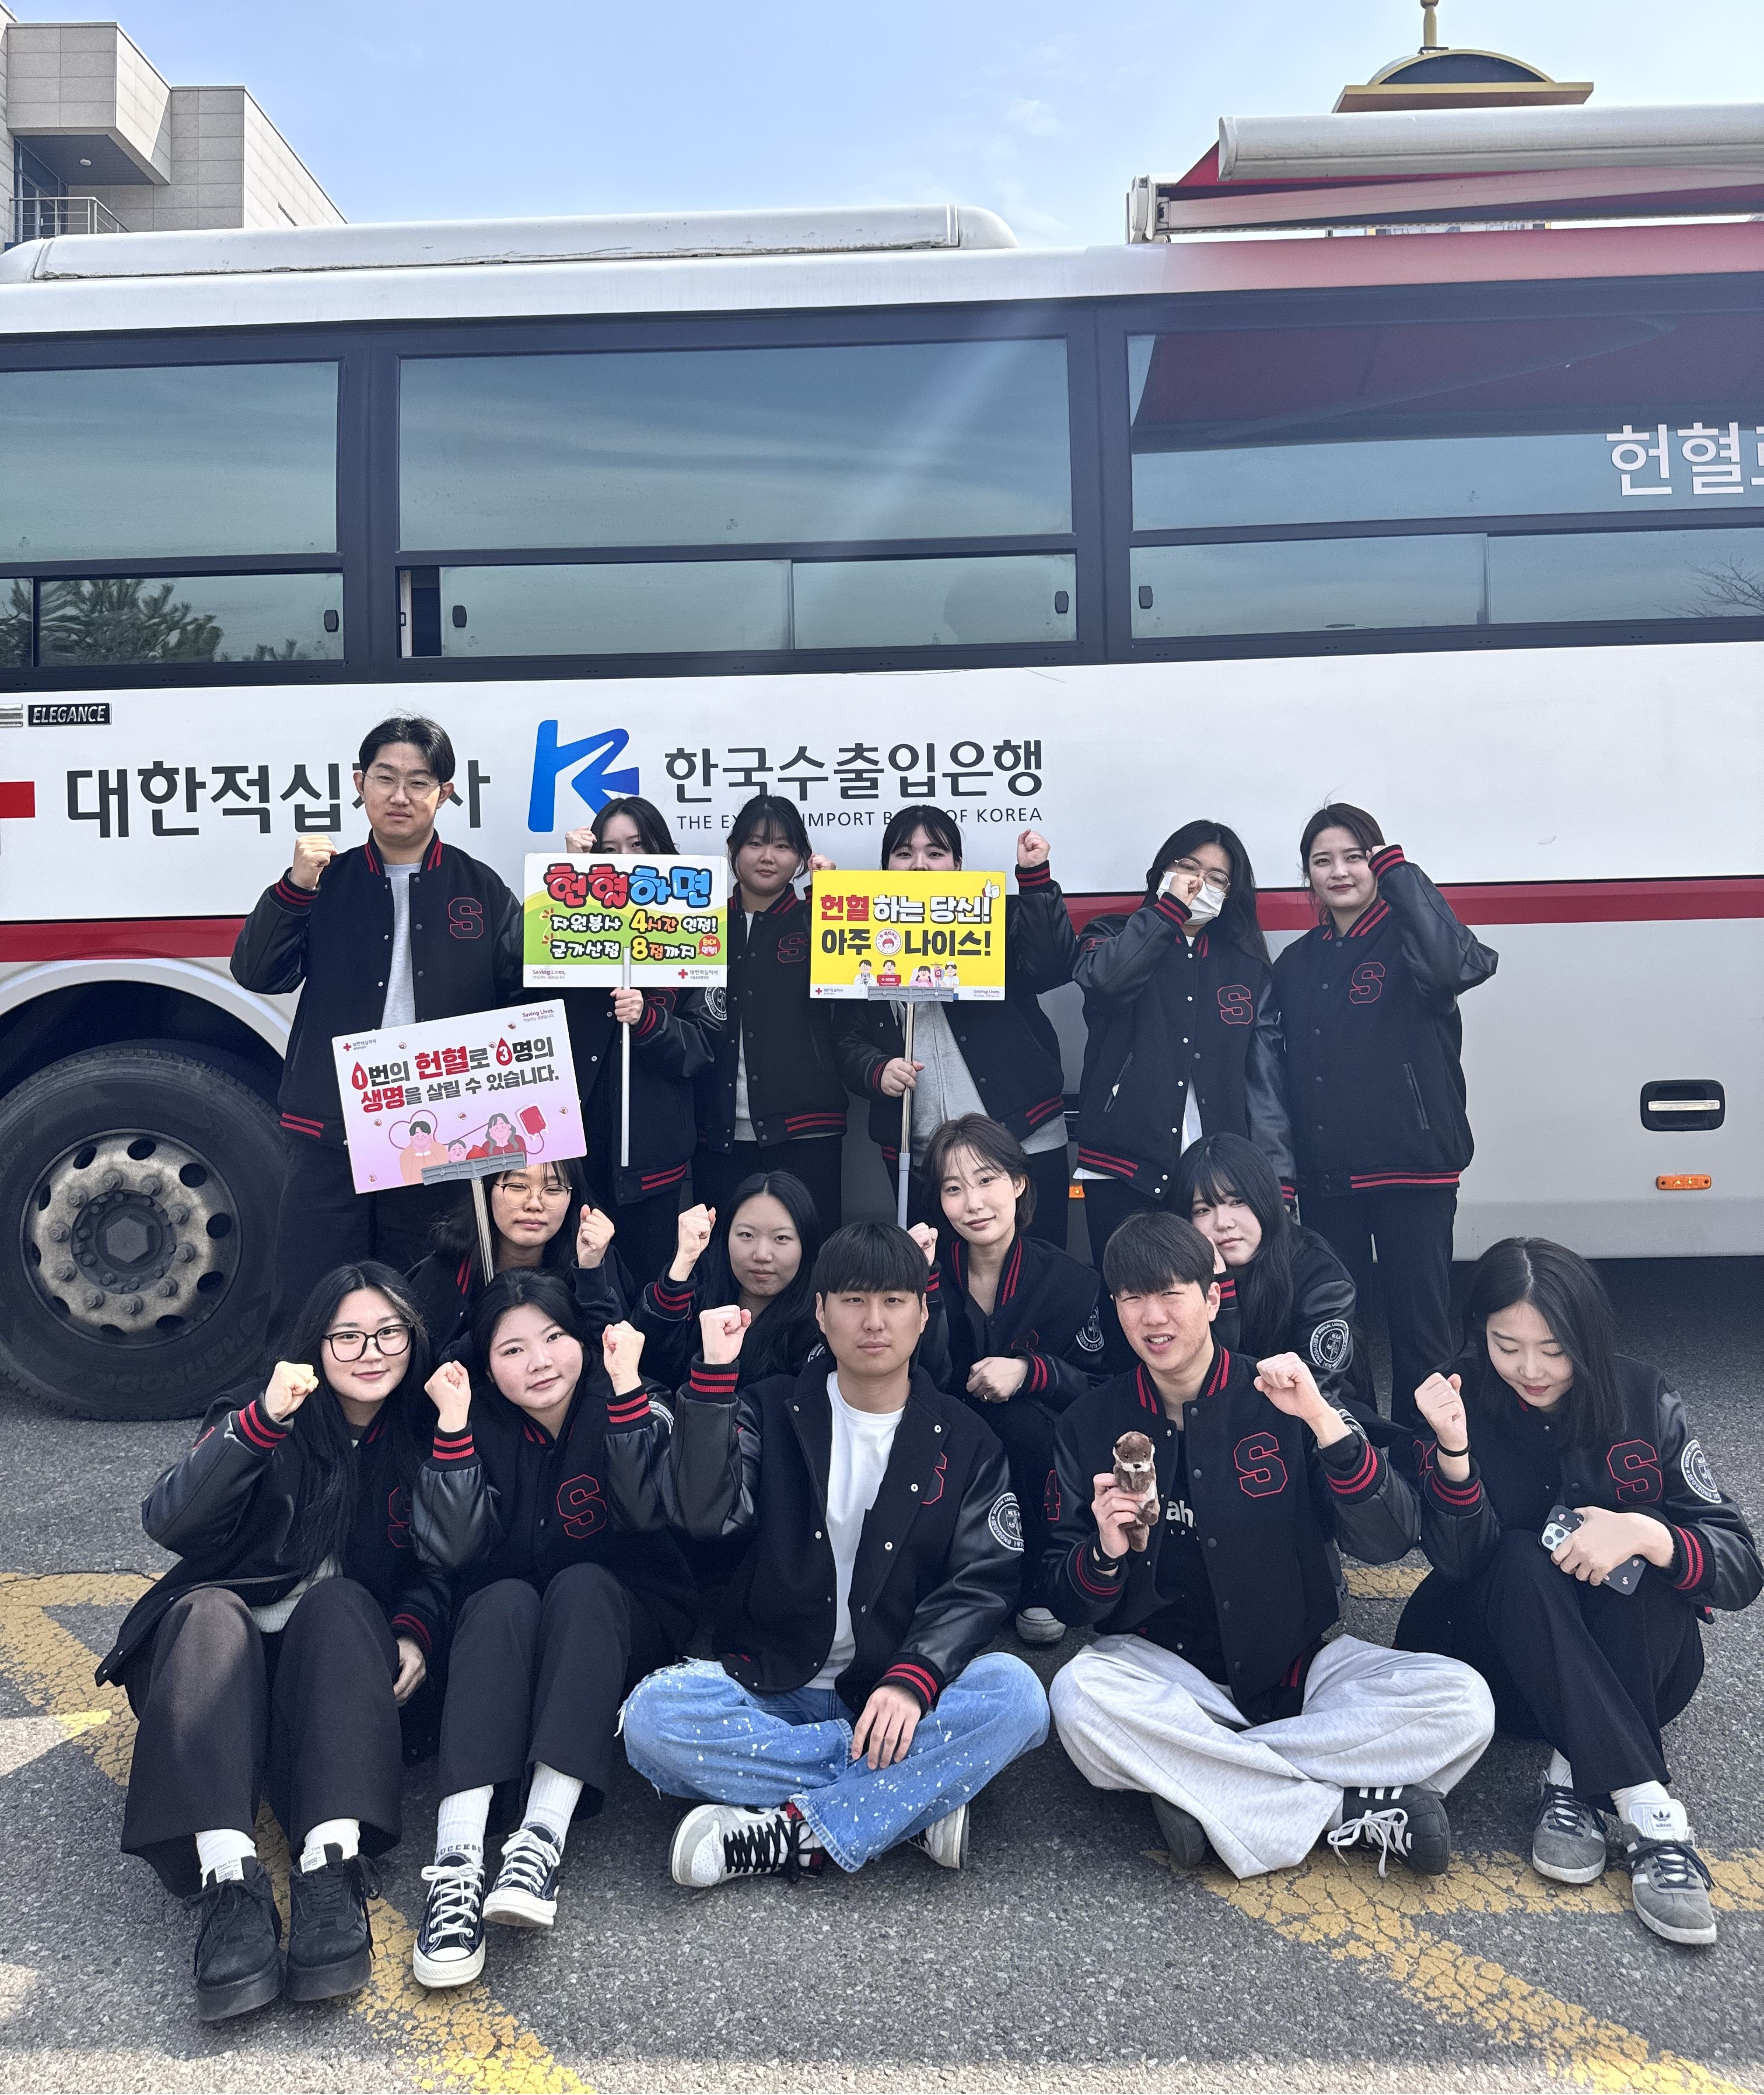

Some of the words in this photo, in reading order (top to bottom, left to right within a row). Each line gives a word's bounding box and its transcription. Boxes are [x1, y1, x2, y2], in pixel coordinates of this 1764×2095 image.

[1606, 422, 1764, 496] 헌혈
[33, 705, 106, 723] ELEGANCE
[664, 739, 1042, 803] 한국수출입은행
[66, 759, 491, 838] 대한적십사
[677, 815, 712, 829] THE
[945, 809, 968, 823] OF
[977, 807, 1042, 823] KOREA
[544, 863, 712, 908] 헌혈하면
[448, 897, 484, 939] S
[551, 913, 623, 933] 자원봉사
[630, 909, 678, 933] 4시간
[681, 916, 718, 933] 인정!
[930, 896, 992, 924] 당신!
[551, 940, 621, 959] 군가산점
[631, 936, 696, 961] 8점까지
[822, 929, 871, 955] 아주
[905, 930, 991, 956] 나이스!
[1349, 962, 1386, 1004] S
[1217, 984, 1254, 1025] S
[354, 1061, 410, 1087] 1번의
[415, 1046, 490, 1080] 헌혈로
[498, 1036, 554, 1063] 3명의
[361, 1085, 422, 1113] 생명을
[426, 1080, 461, 1101] 살릴
[465, 1077, 482, 1095] 수
[487, 1064, 559, 1092] 있습니다.
[1233, 1431, 1288, 1498] S
[1606, 1438, 1663, 1504] S
[556, 1474, 607, 1539] S
[1166, 1500, 1196, 1528] ah
